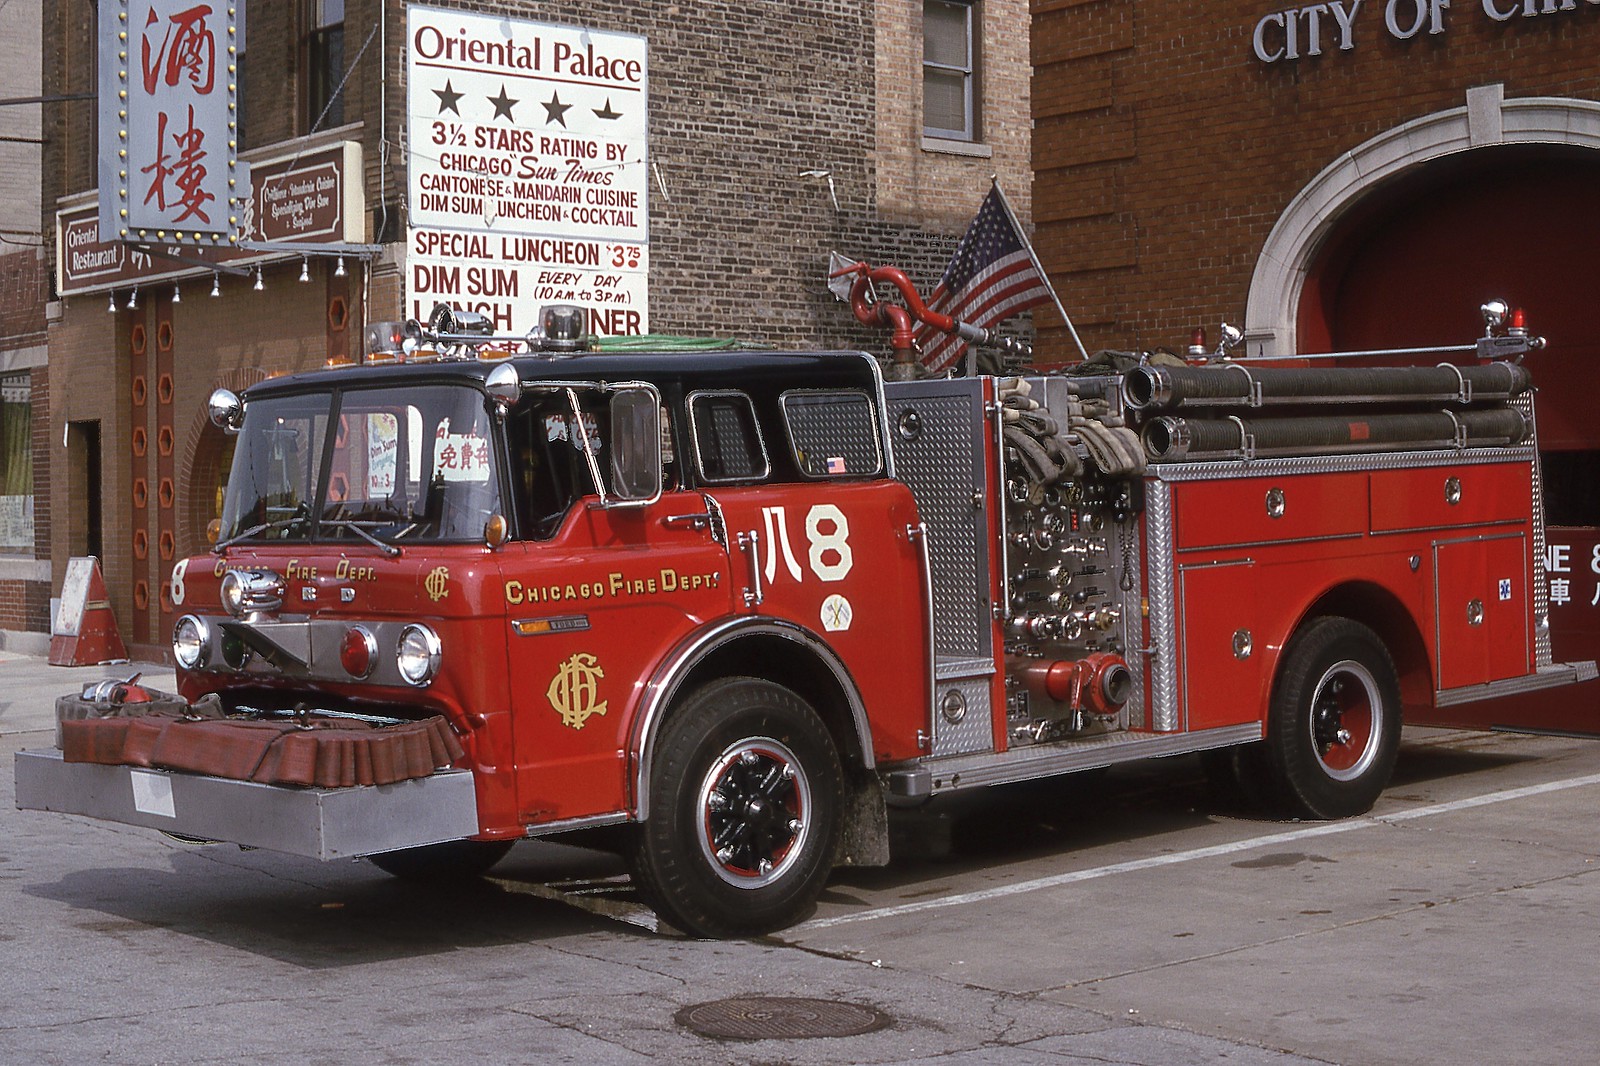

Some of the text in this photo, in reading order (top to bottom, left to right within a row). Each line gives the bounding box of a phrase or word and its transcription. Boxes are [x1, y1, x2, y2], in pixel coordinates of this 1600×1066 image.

[1253, 1, 1360, 62] CITY
[414, 26, 641, 82] Oriental Palace
[474, 127, 534, 152] STARS
[541, 137, 597, 158] RATING
[606, 143, 627, 162] BY
[440, 152, 512, 177] CHICAGO
[420, 173, 504, 197] CANTONESE
[513, 182, 581, 204] MANDARIN
[586, 189, 638, 208] CUISINE
[420, 194, 448, 212] DIM
[452, 197, 483, 215] SUM
[495, 200, 561, 222] UNCHEON
[571, 206, 638, 228] COCKTAIL
[69, 224, 98, 248] Oriental
[415, 231, 493, 259] SPECIAL
[502, 237, 599, 266] LUNCHEON
[73, 244, 118, 271] Restaurant
[414, 265, 518, 297] DIM SUM
[537, 271, 622, 288] EVERY DAY
[578, 290, 592, 301] to
[805, 504, 854, 582] 8
[286, 559, 318, 580] FIRE
[505, 581, 604, 605] CHICAGO
[608, 572, 657, 597] FIRE
